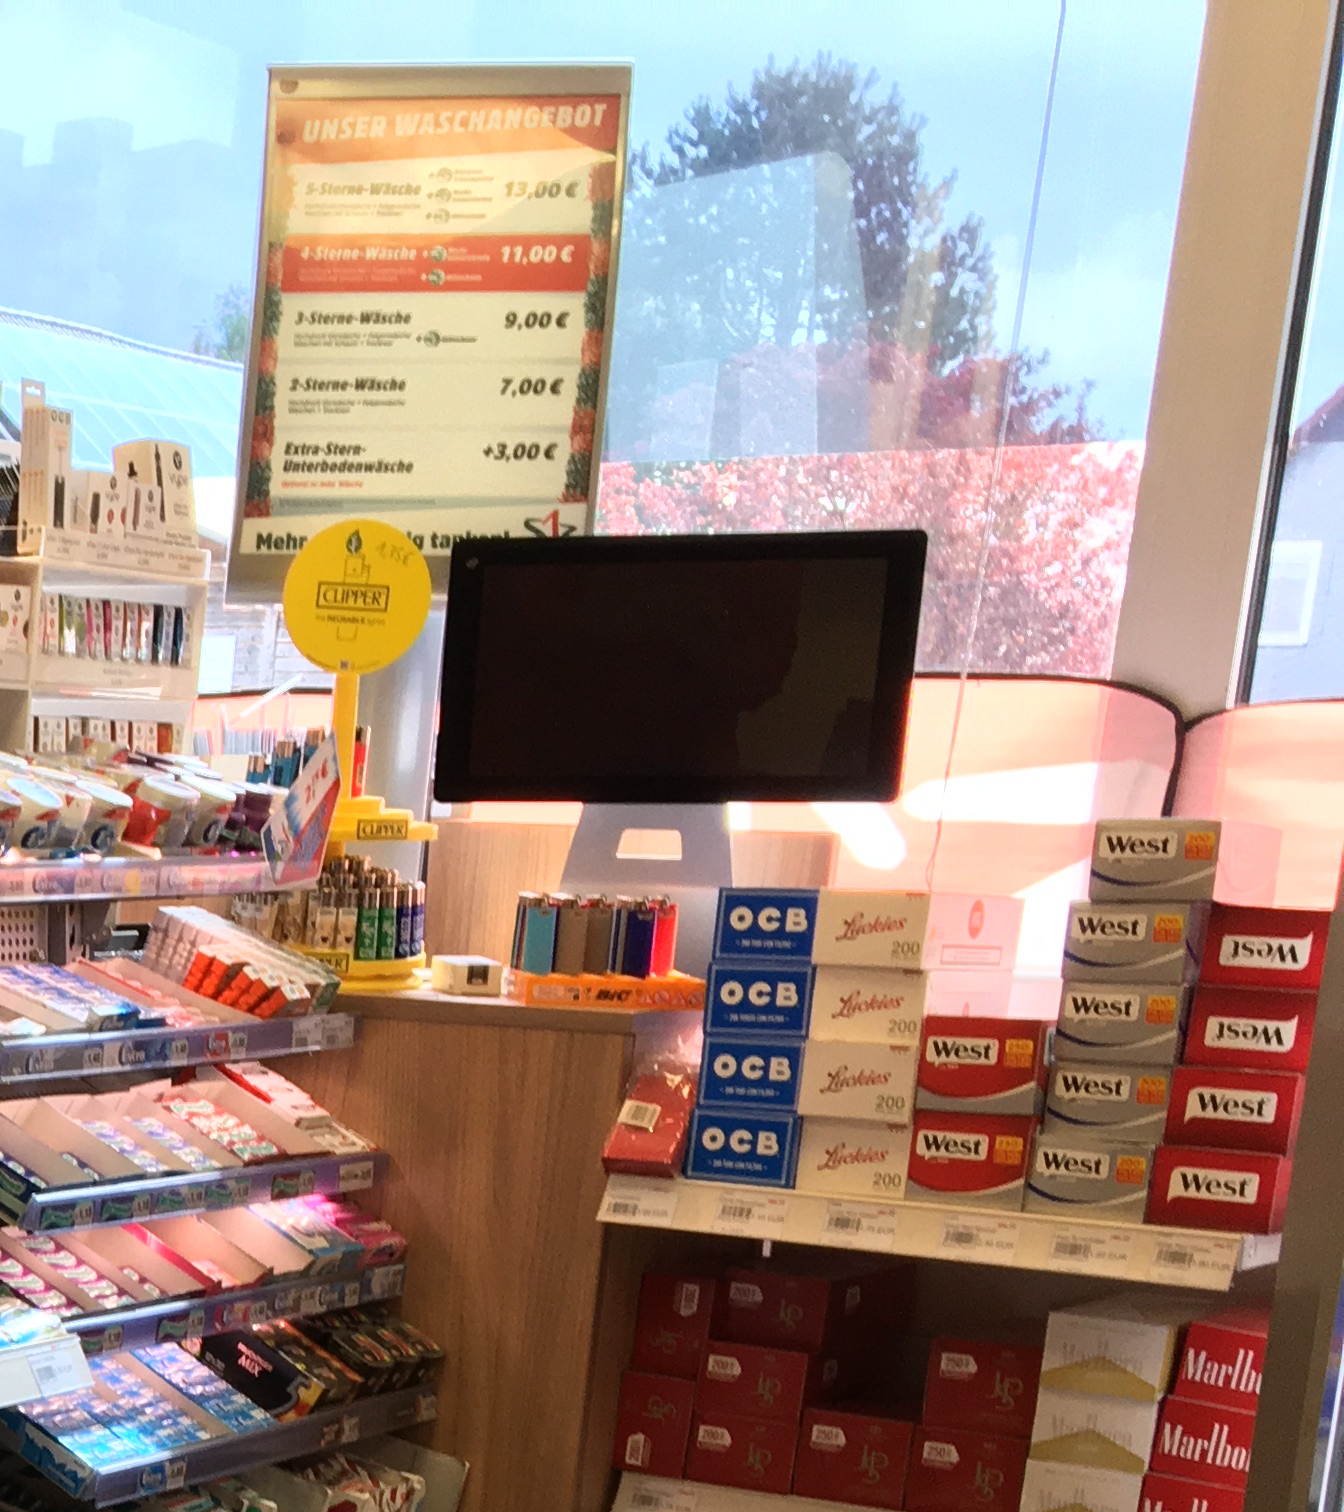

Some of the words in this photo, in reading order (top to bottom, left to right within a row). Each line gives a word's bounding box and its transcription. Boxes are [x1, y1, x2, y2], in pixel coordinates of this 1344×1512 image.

[302, 115, 388, 144] UNSER
[395, 103, 608, 138] WASCHANGEBOT
[304, 180, 422, 198] 5-Sterne-Wäsche
[503, 179, 560, 200] 13,00
[564, 180, 582, 198] €
[300, 245, 418, 262] 4-Sterne-Wäsche
[500, 244, 558, 266] 11,00
[559, 245, 576, 264] €
[294, 310, 412, 328] 3-Sterne-Wäsche
[504, 311, 552, 332] 9,00
[555, 311, 572, 330] €
[288, 377, 408, 394] 2-Sterne-Wäsche
[499, 377, 548, 398] 7,00
[549, 377, 566, 396] €
[283, 441, 368, 458] Extra-Stern-
[482, 442, 542, 464] +3,00
[543, 442, 560, 462] €
[282, 459, 416, 476] Unterbodenwäsche
[255, 531, 308, 552] Mehr
[322, 586, 384, 608] CLIPPER
[1105, 834, 1176, 858] West
[729, 905, 810, 934] OCB
[834, 912, 908, 942] Luckies
[1077, 916, 1144, 938] West
[890, 940, 920, 960] 200
[1229, 938, 1300, 966] West
[719, 980, 800, 1008] OCB
[831, 990, 906, 1020] Luckies
[1071, 996, 1136, 1018] West
[888, 1018, 918, 1034] 200
[1214, 1020, 1286, 1048] West
[932, 1040, 996, 1062] West
[713, 1053, 792, 1082] OCB
[819, 1064, 892, 1094] Luckies
[1061, 1074, 1126, 1098] West
[874, 1094, 906, 1112] 200
[1197, 1092, 1270, 1120] West
[701, 1126, 780, 1156] OCB
[923, 1133, 986, 1156] West
[816, 1141, 890, 1172] Luckies
[1043, 1151, 1106, 1176] West
[872, 1172, 902, 1190] 200
[1180, 1172, 1252, 1200] West
